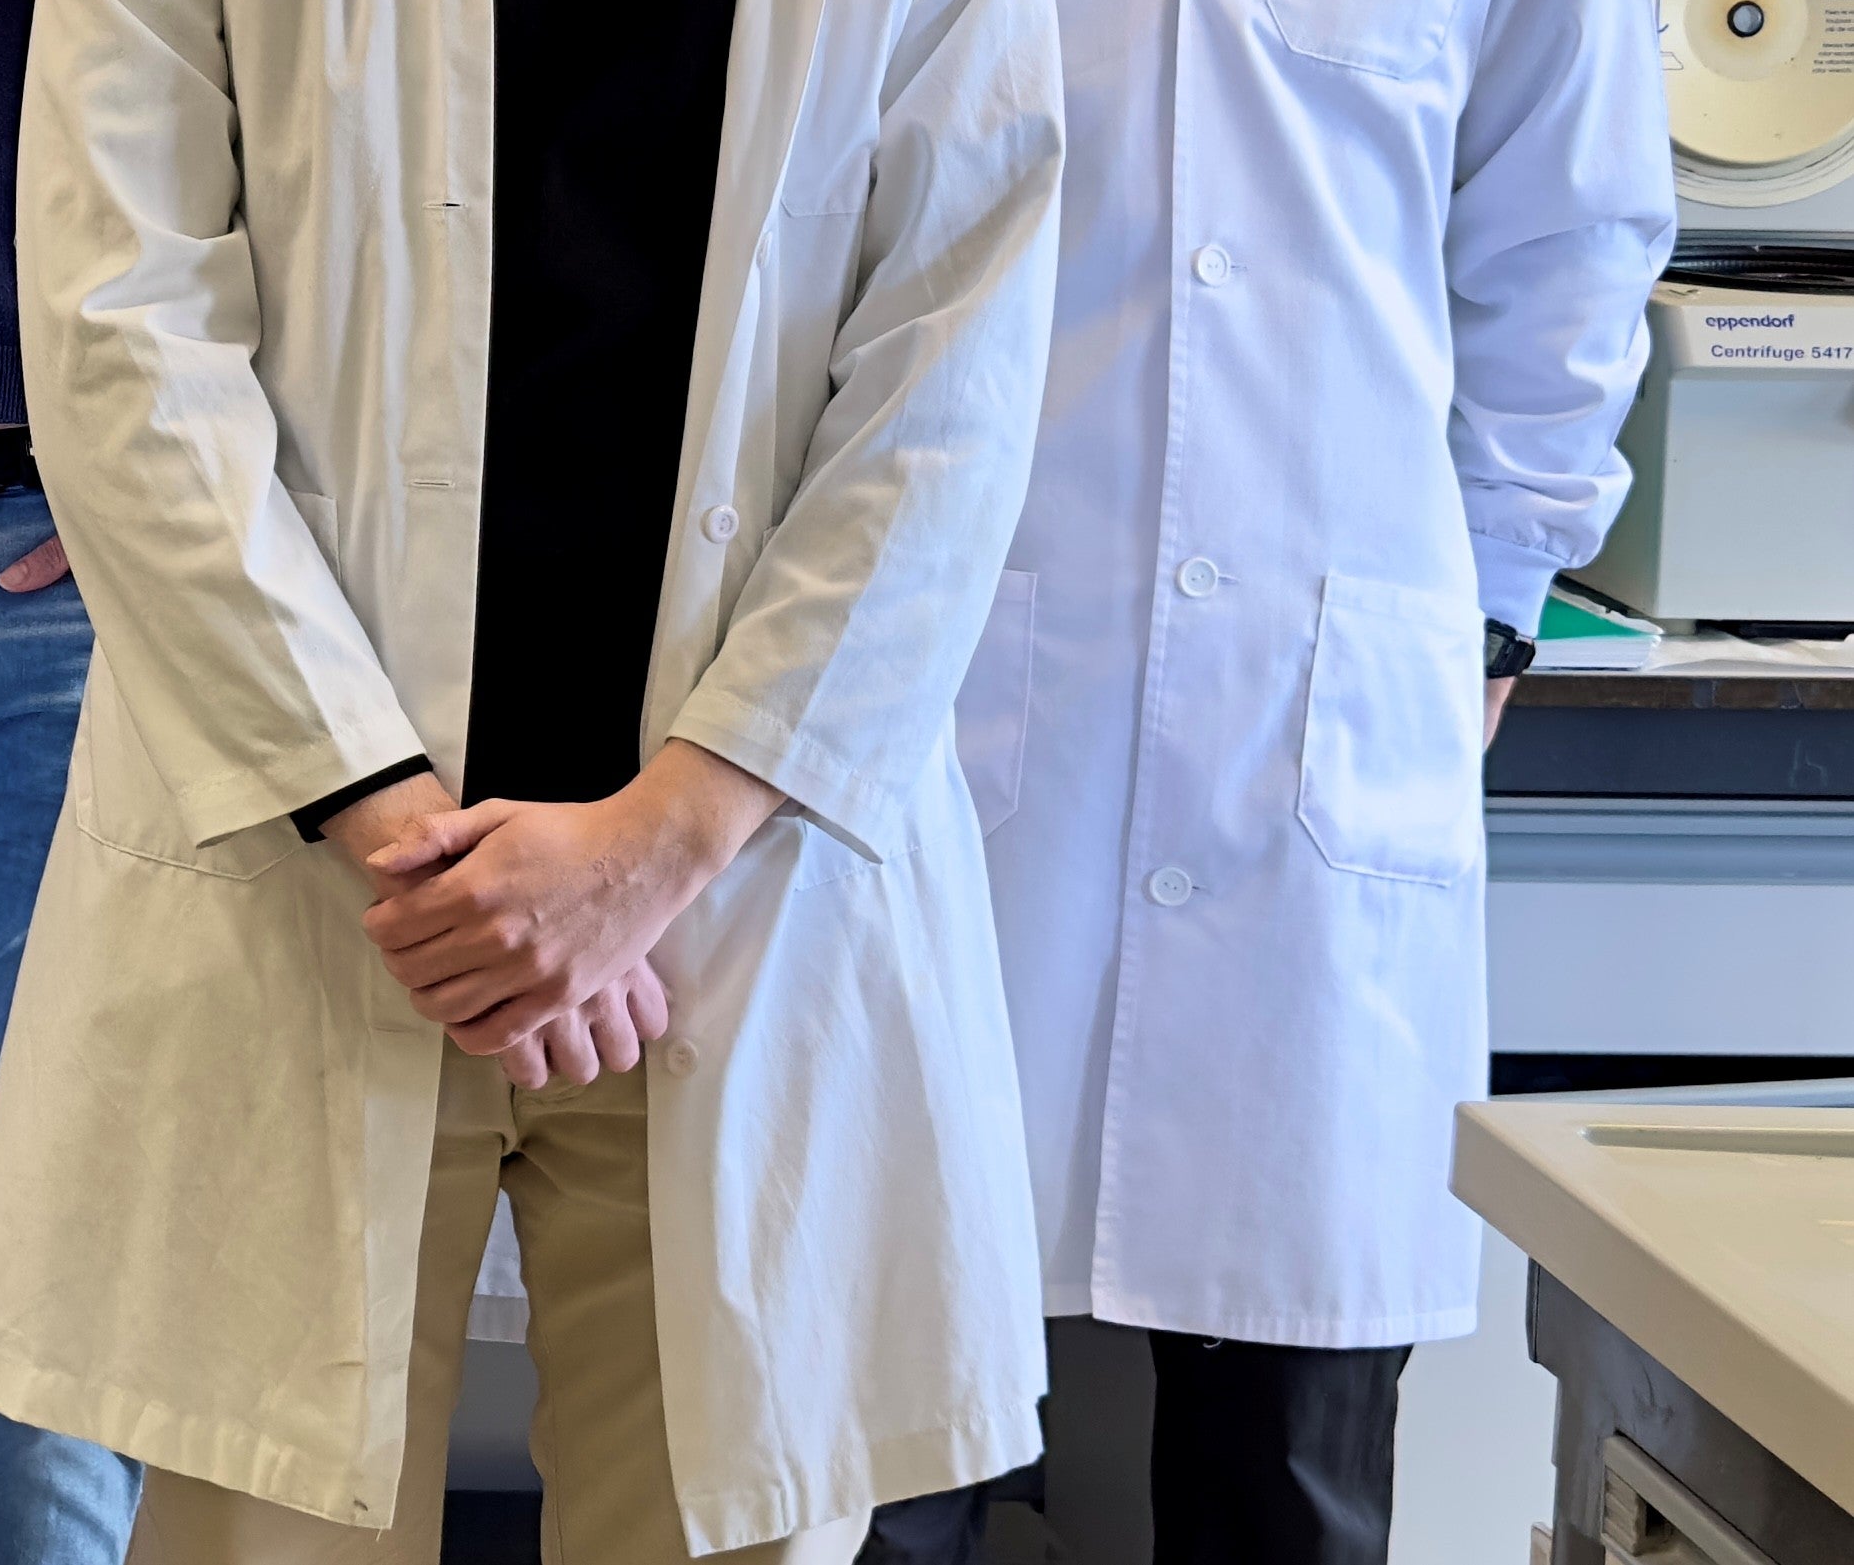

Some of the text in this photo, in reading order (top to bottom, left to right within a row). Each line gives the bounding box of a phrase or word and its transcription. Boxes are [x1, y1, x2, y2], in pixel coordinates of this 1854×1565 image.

[1705, 314, 1795, 331] eppendorf
[1711, 344, 1854, 362] Centrifuge 5417
